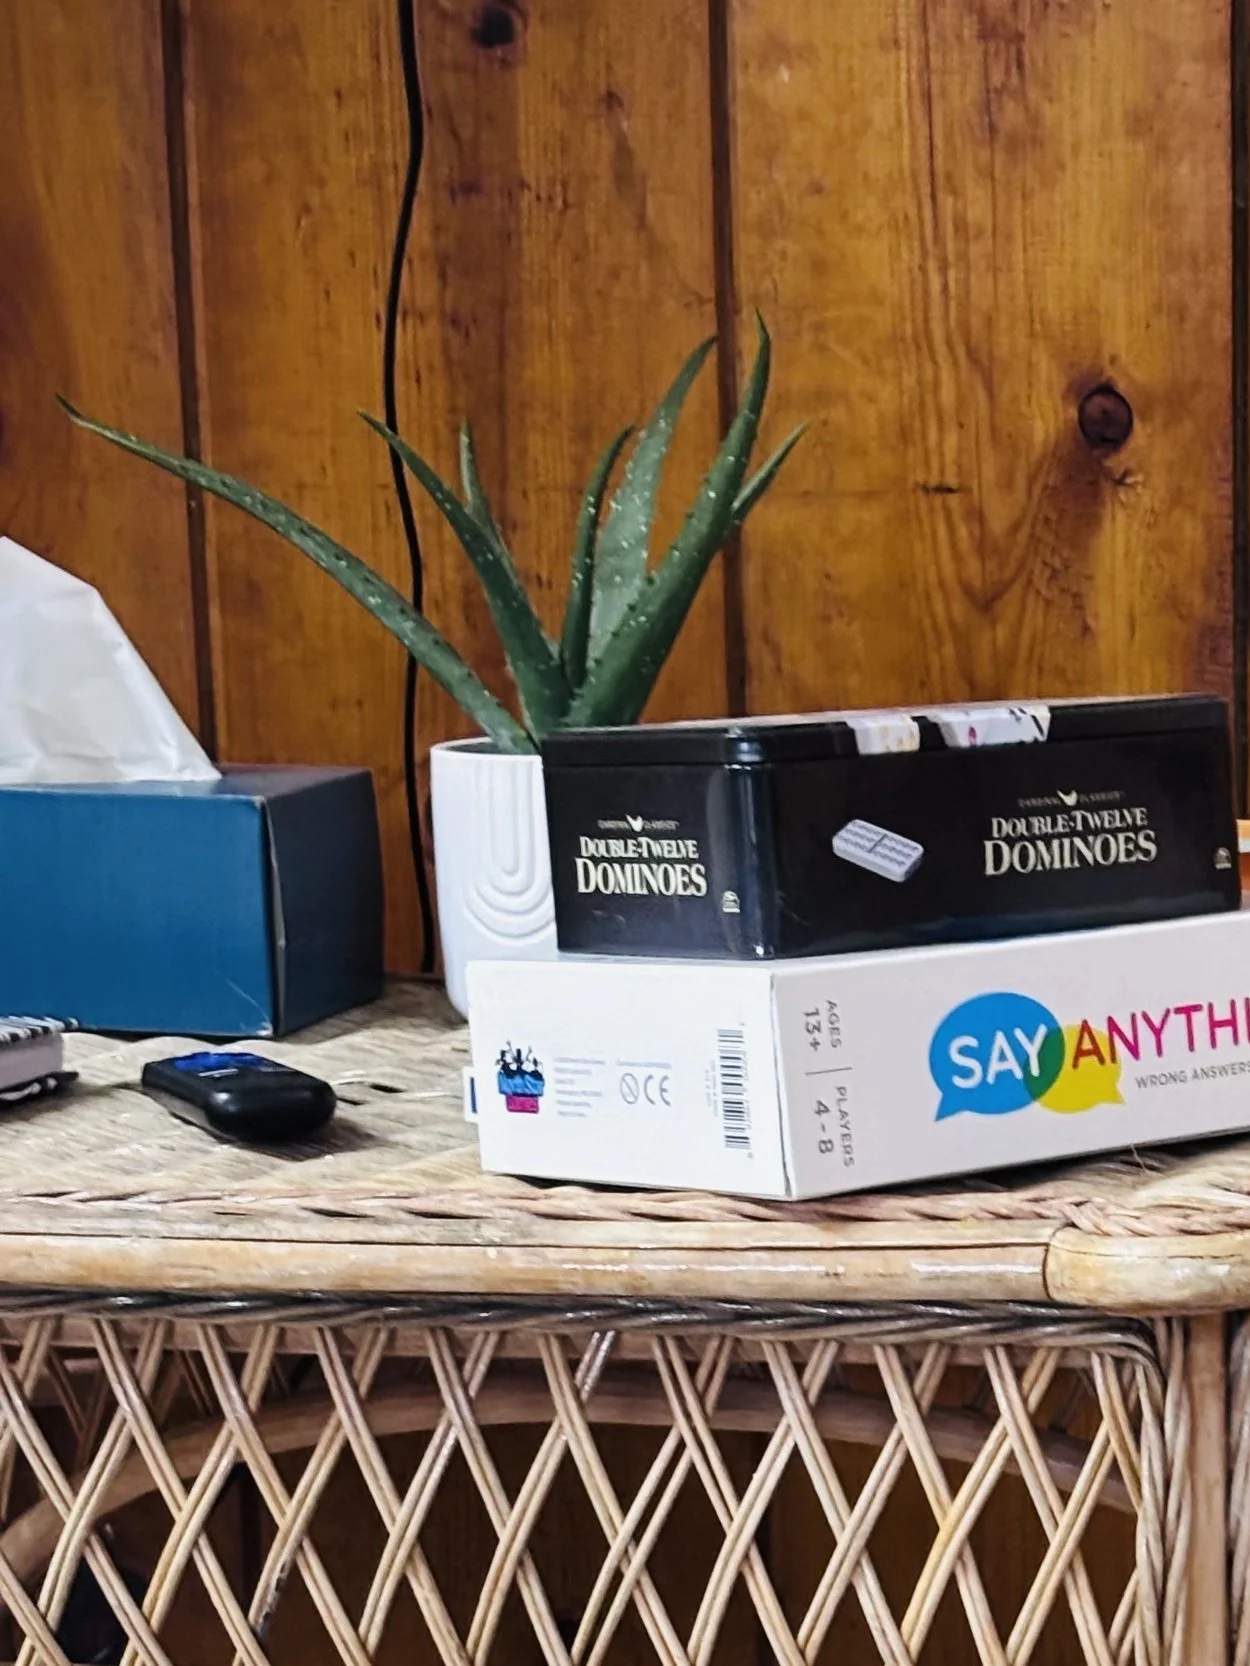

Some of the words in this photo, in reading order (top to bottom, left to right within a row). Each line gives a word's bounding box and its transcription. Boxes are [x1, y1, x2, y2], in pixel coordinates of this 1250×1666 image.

[991, 807, 1148, 839] DOUBLE-TWELVE
[579, 836, 700, 859] DOUBLE-TWELVE
[984, 829, 1158, 876] DOMINOES
[575, 857, 708, 897] DOMINOES
[804, 1007, 821, 1053] 13+
[826, 1000, 842, 1049] AGES
[948, 1024, 1048, 1089] SAY
[1136, 1069, 1188, 1090] WRONG
[835, 1085, 855, 1169] PLAYERS
